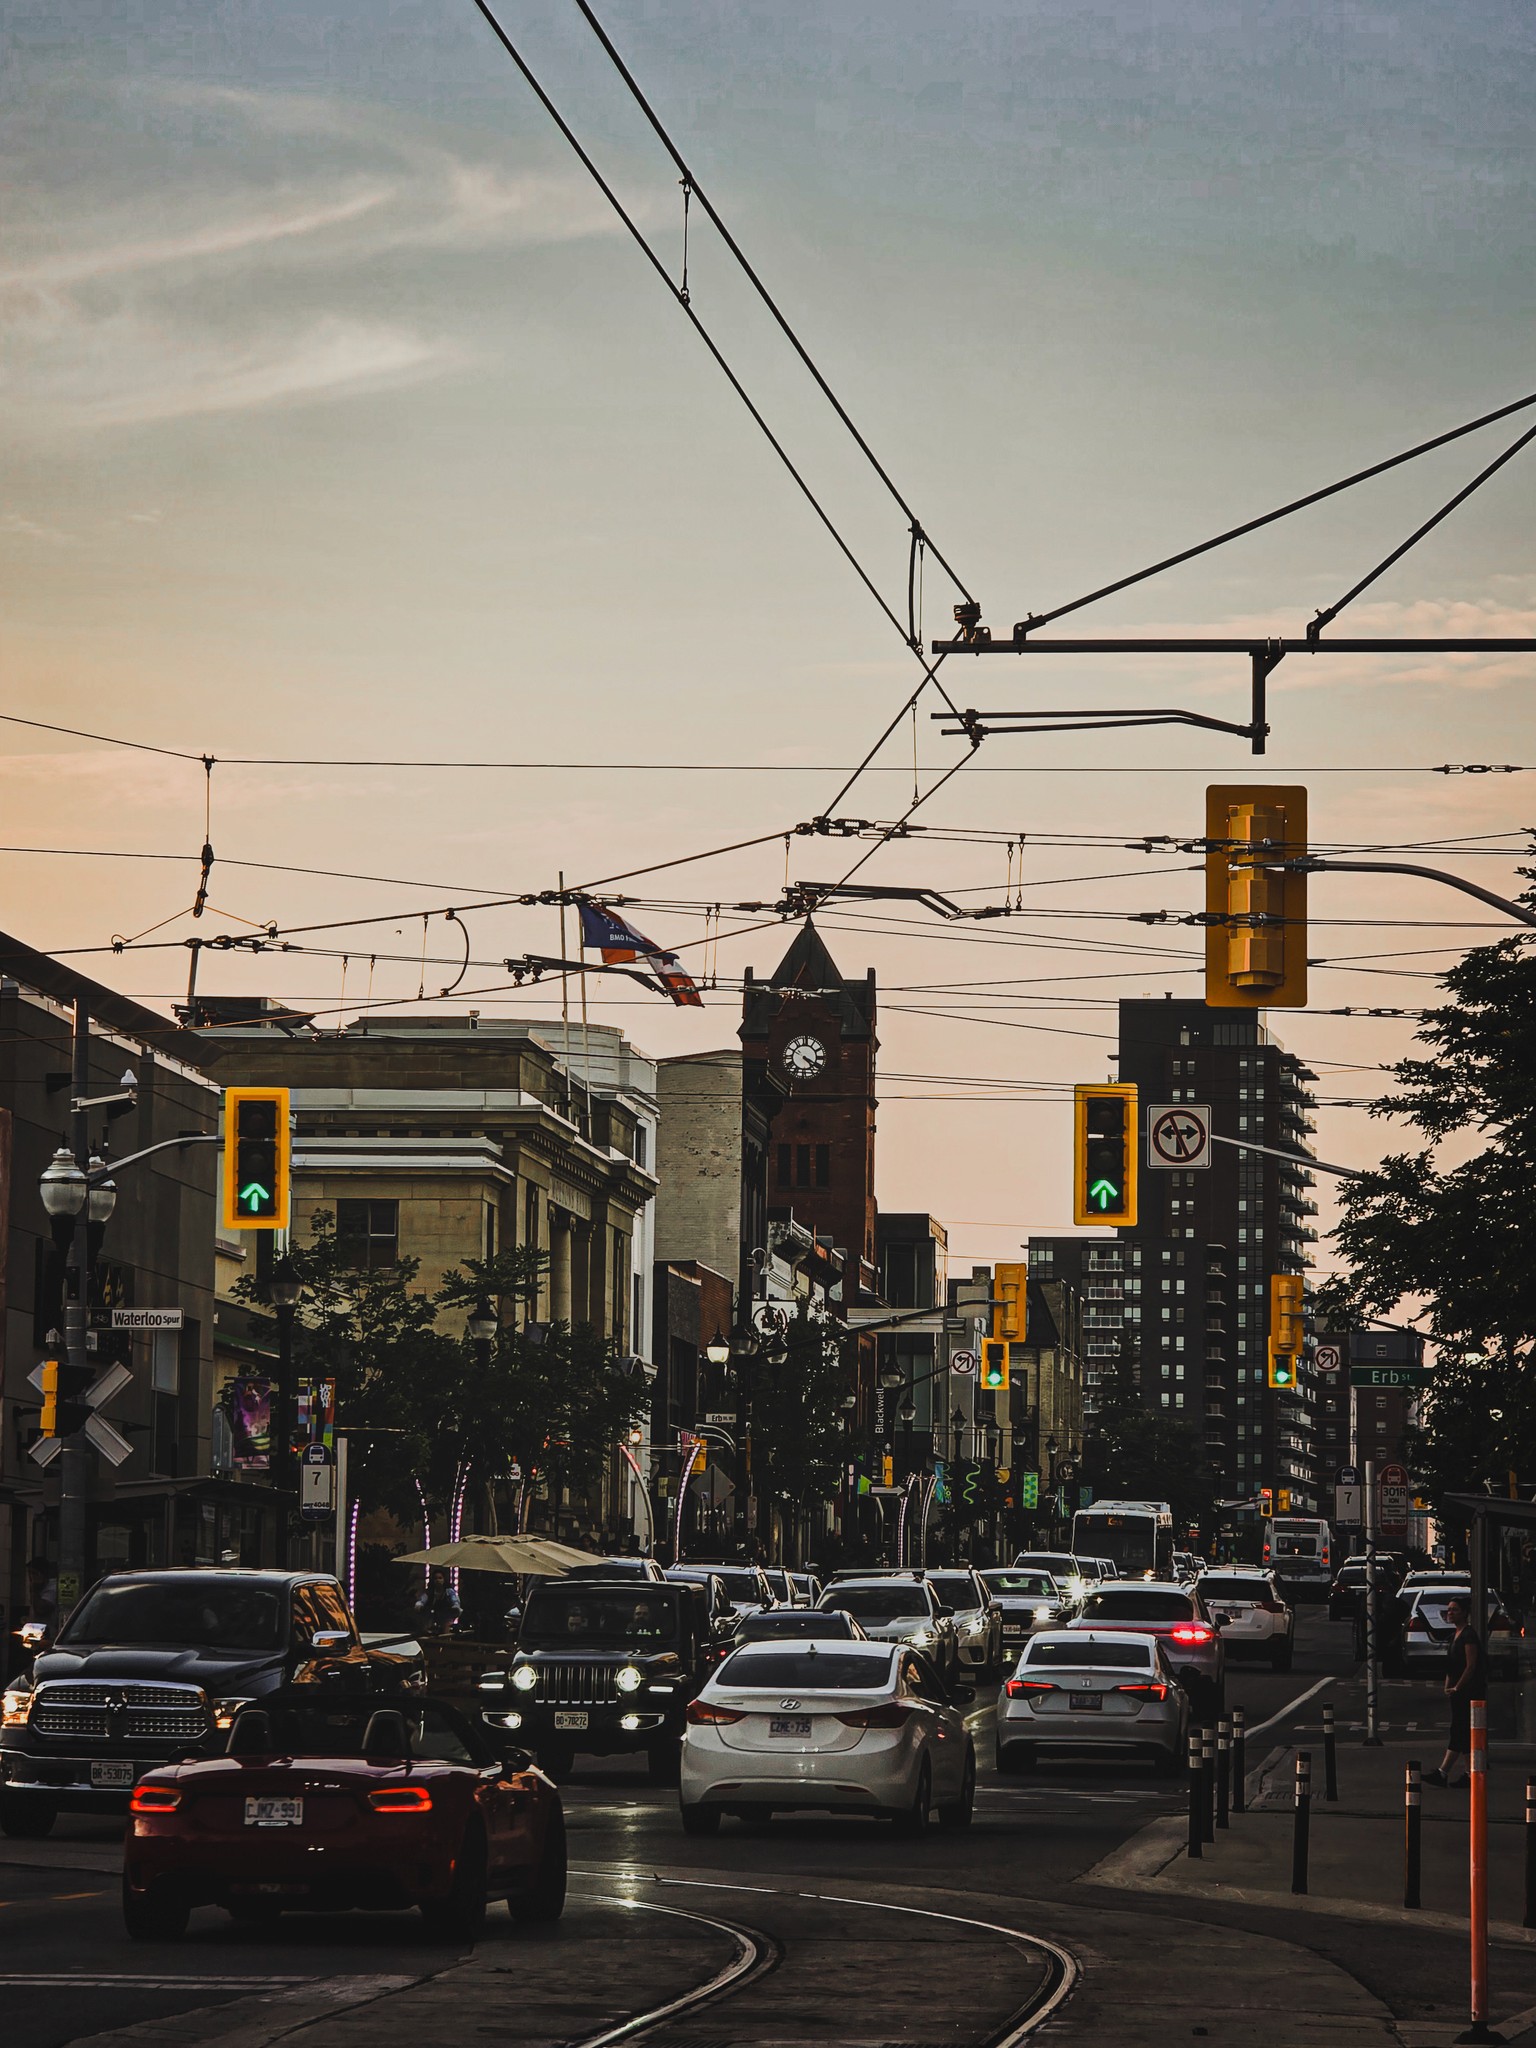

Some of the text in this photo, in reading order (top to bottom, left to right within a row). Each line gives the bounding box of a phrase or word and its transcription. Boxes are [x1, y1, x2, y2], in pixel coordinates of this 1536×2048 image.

[114, 1312, 180, 1326] Waterloo Spur
[1371, 1370, 1399, 1384] Erb
[875, 1388, 886, 1434] Blackwell
[312, 1472, 323, 1485] 7
[1344, 1492, 1353, 1504] 7
[1383, 1487, 1406, 1496] 301R
